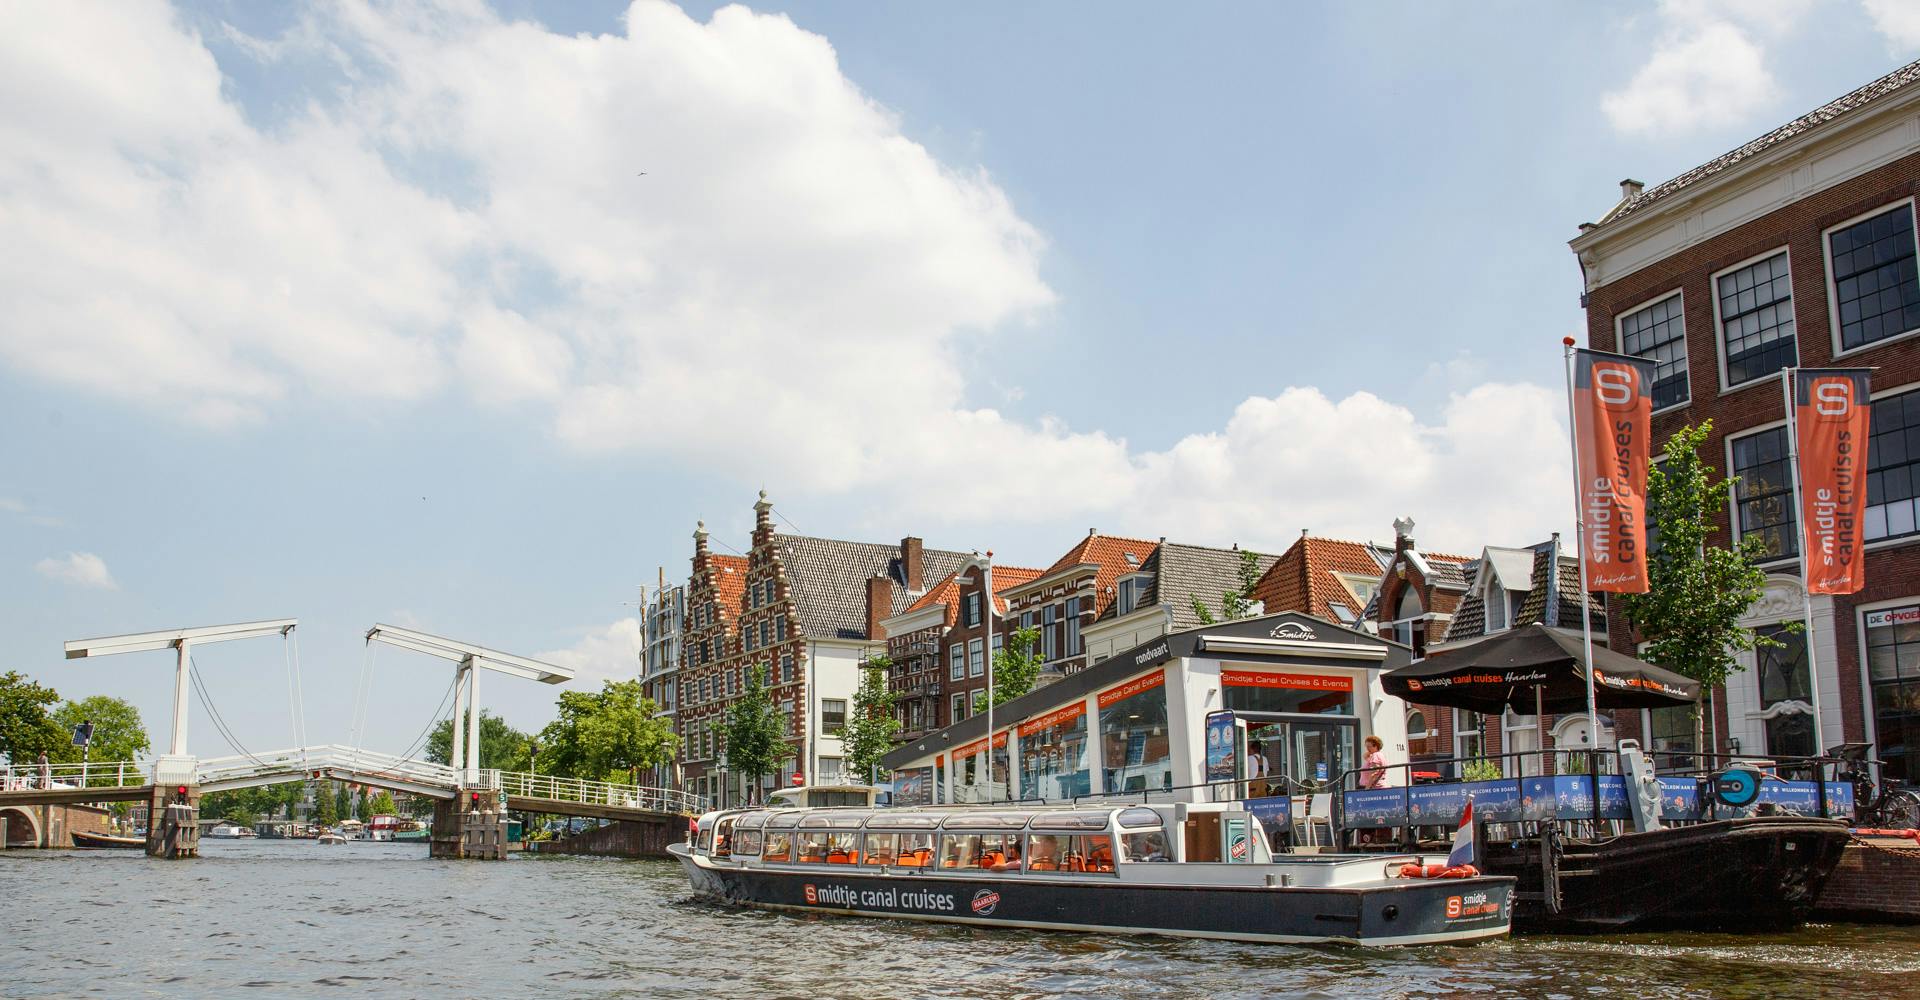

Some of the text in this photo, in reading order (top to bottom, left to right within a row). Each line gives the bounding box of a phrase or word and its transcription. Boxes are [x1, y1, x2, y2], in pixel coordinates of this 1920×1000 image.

[1597, 369, 1632, 404] S
[1817, 383, 1848, 415] S
[1613, 420, 1635, 564] canal cruises
[1832, 430, 1854, 567] canal cruises
[1588, 477, 1616, 564] smidtje
[1813, 488, 1838, 566] smidtje
[1594, 572, 1636, 586] Haarlem
[1870, 610, 1920, 624] DE OPVOE
[1276, 629, 1317, 640] Smidtje
[1135, 642, 1169, 665] rondvaart
[1100, 674, 1164, 704] Smidtje Canal Events
[1222, 674, 1349, 688] Smidtje Canal Cruises & Events
[1422, 677, 1452, 687] smidtje
[1453, 674, 1472, 684] canal
[1473, 673, 1503, 684] cruises
[1504, 670, 1547, 682] Haarlem
[1059, 705, 1080, 719] Cruises
[861, 887, 898, 908] canal
[901, 888, 955, 911] cruises
[1463, 892, 1487, 906] smidtje
[1463, 904, 1480, 916] canal
